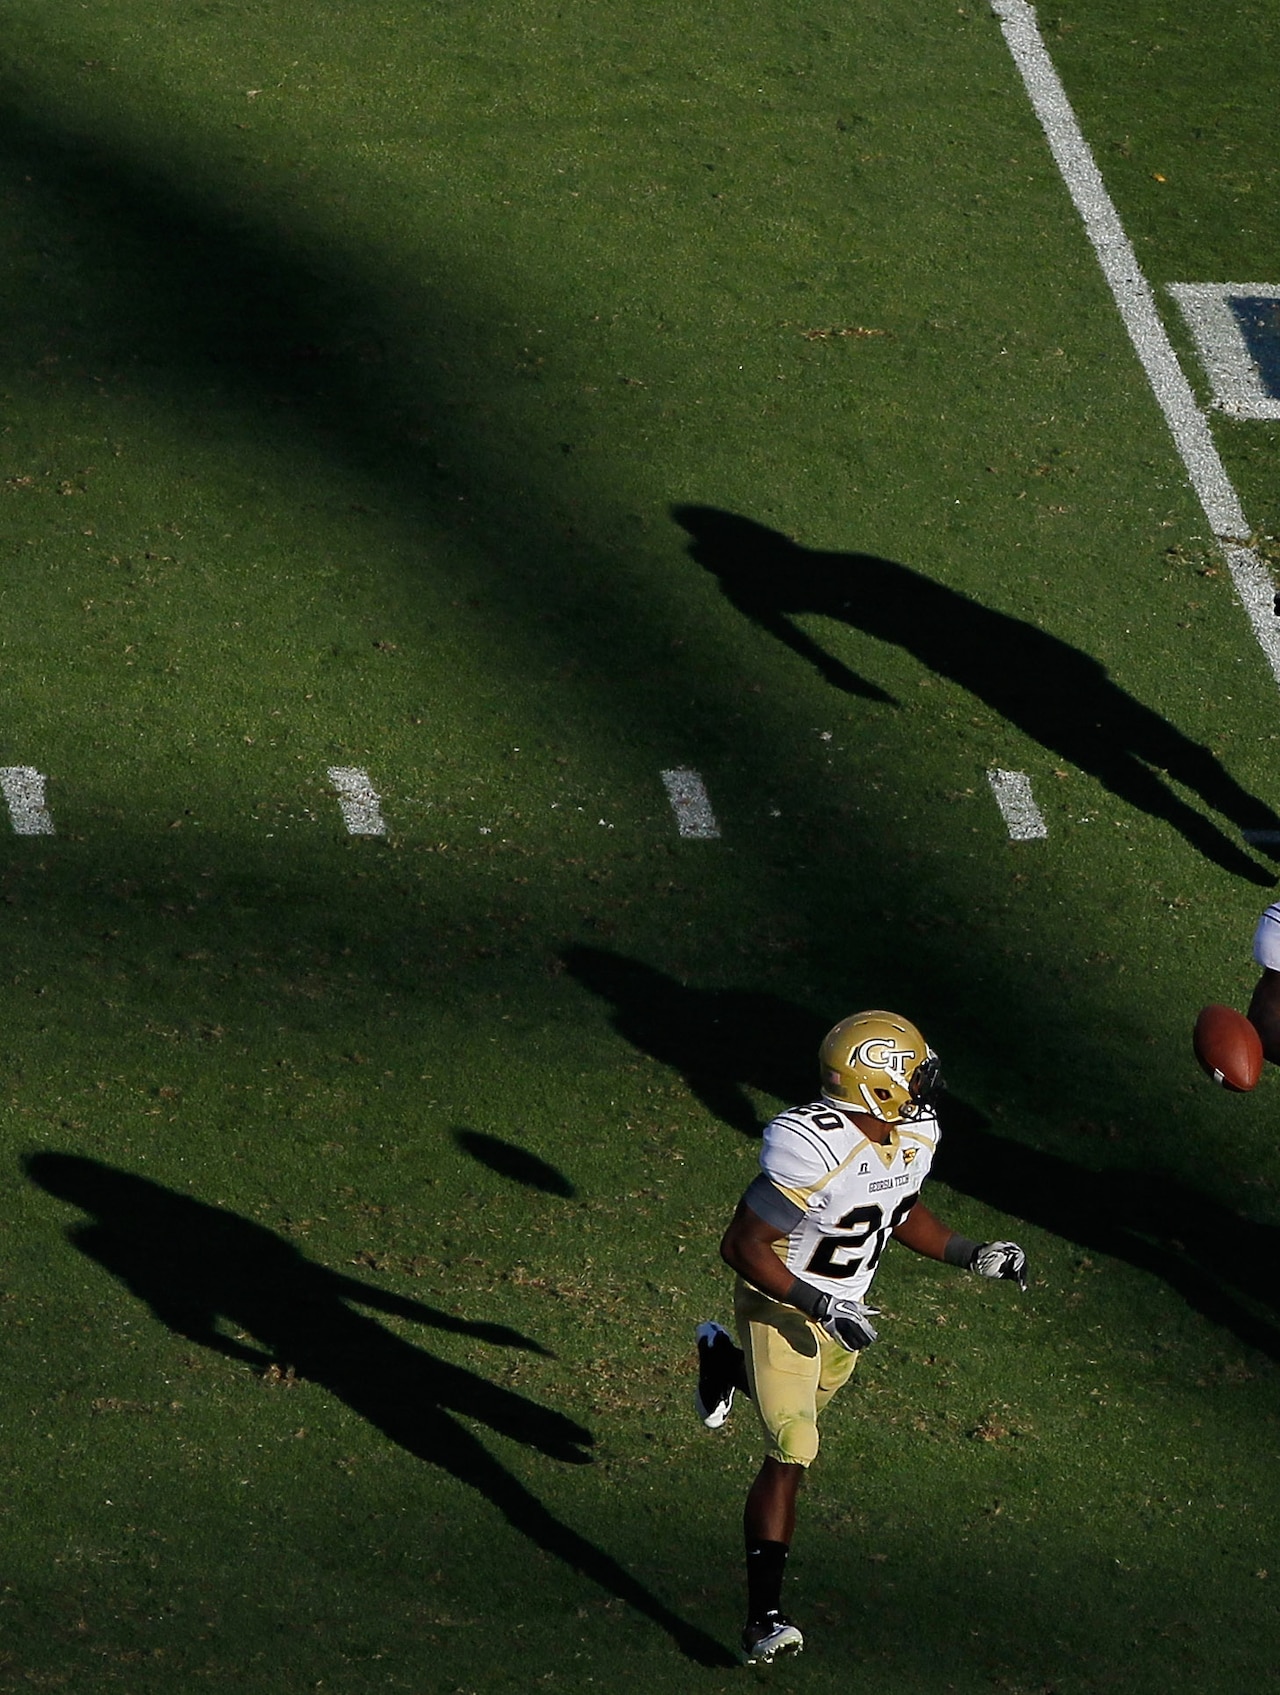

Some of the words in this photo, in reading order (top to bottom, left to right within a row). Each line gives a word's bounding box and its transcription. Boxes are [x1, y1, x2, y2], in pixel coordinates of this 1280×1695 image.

[858, 1038, 916, 1074] GT
[787, 1102, 845, 1132] 20
[868, 1178, 894, 1193] GEORGIA
